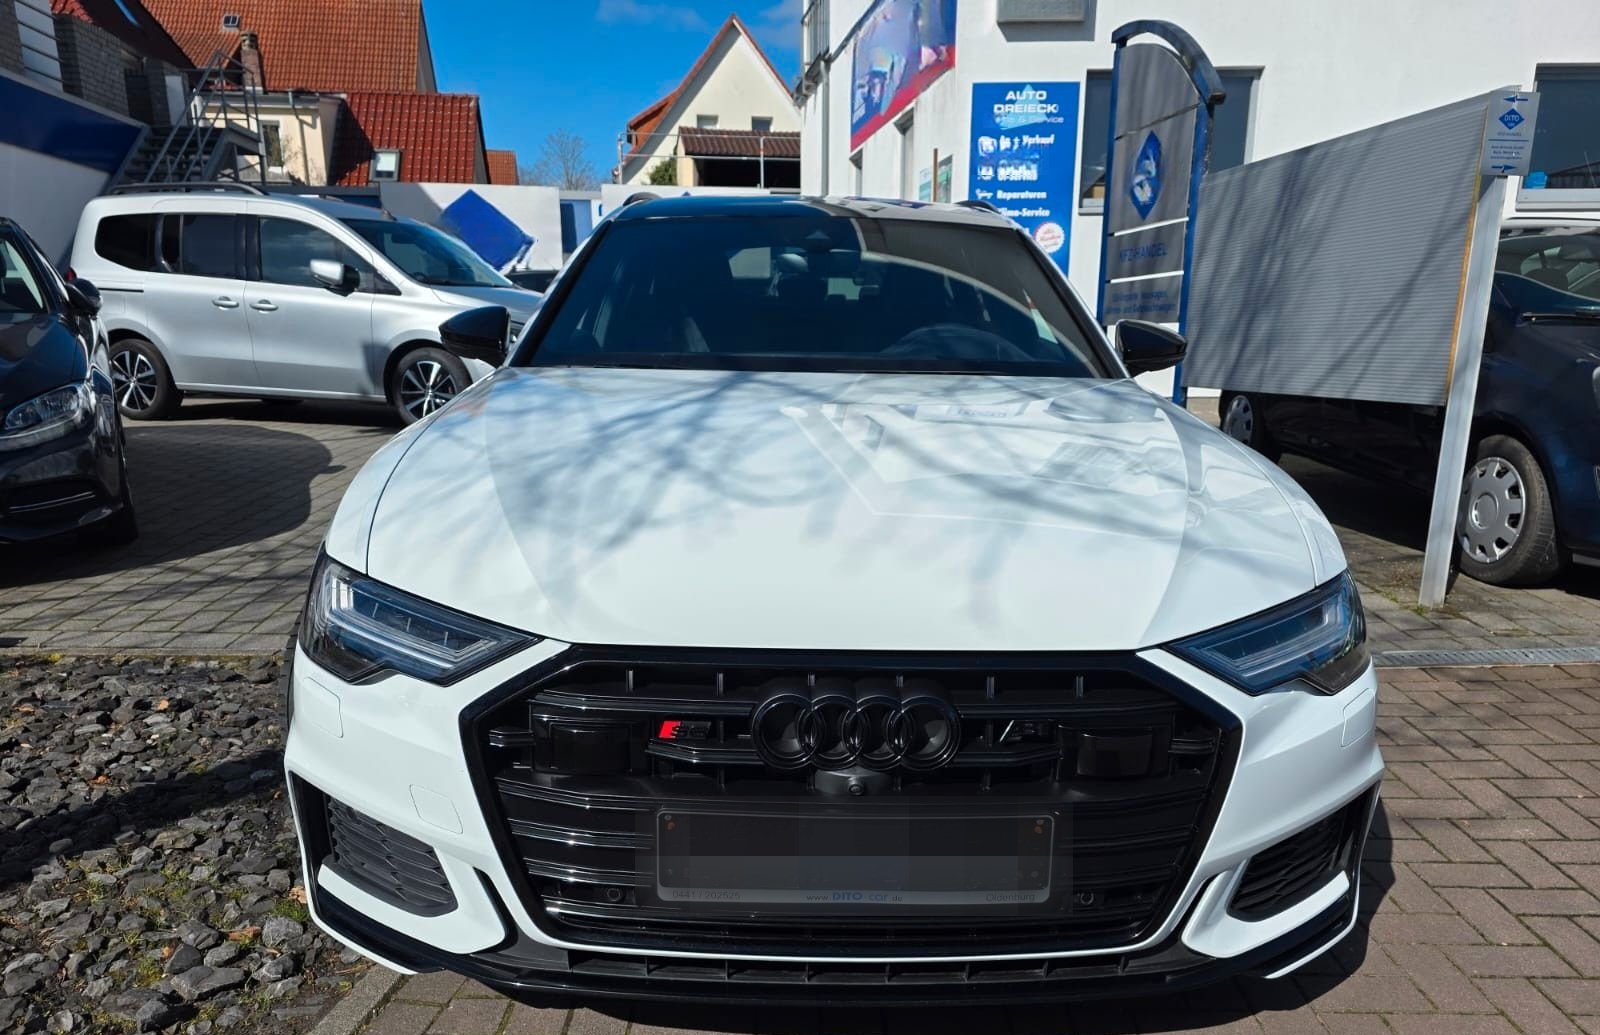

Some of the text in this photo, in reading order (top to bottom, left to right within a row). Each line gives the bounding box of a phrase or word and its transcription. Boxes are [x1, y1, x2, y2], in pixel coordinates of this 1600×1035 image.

[1005, 91, 1047, 100] AUTO
[993, 104, 1059, 113] DREIECK
[1504, 114, 1520, 122] DITO
[997, 190, 1047, 200] Reparaturen
[673, 891, 696, 899] 0441
[986, 893, 1035, 902] Oldenburg
